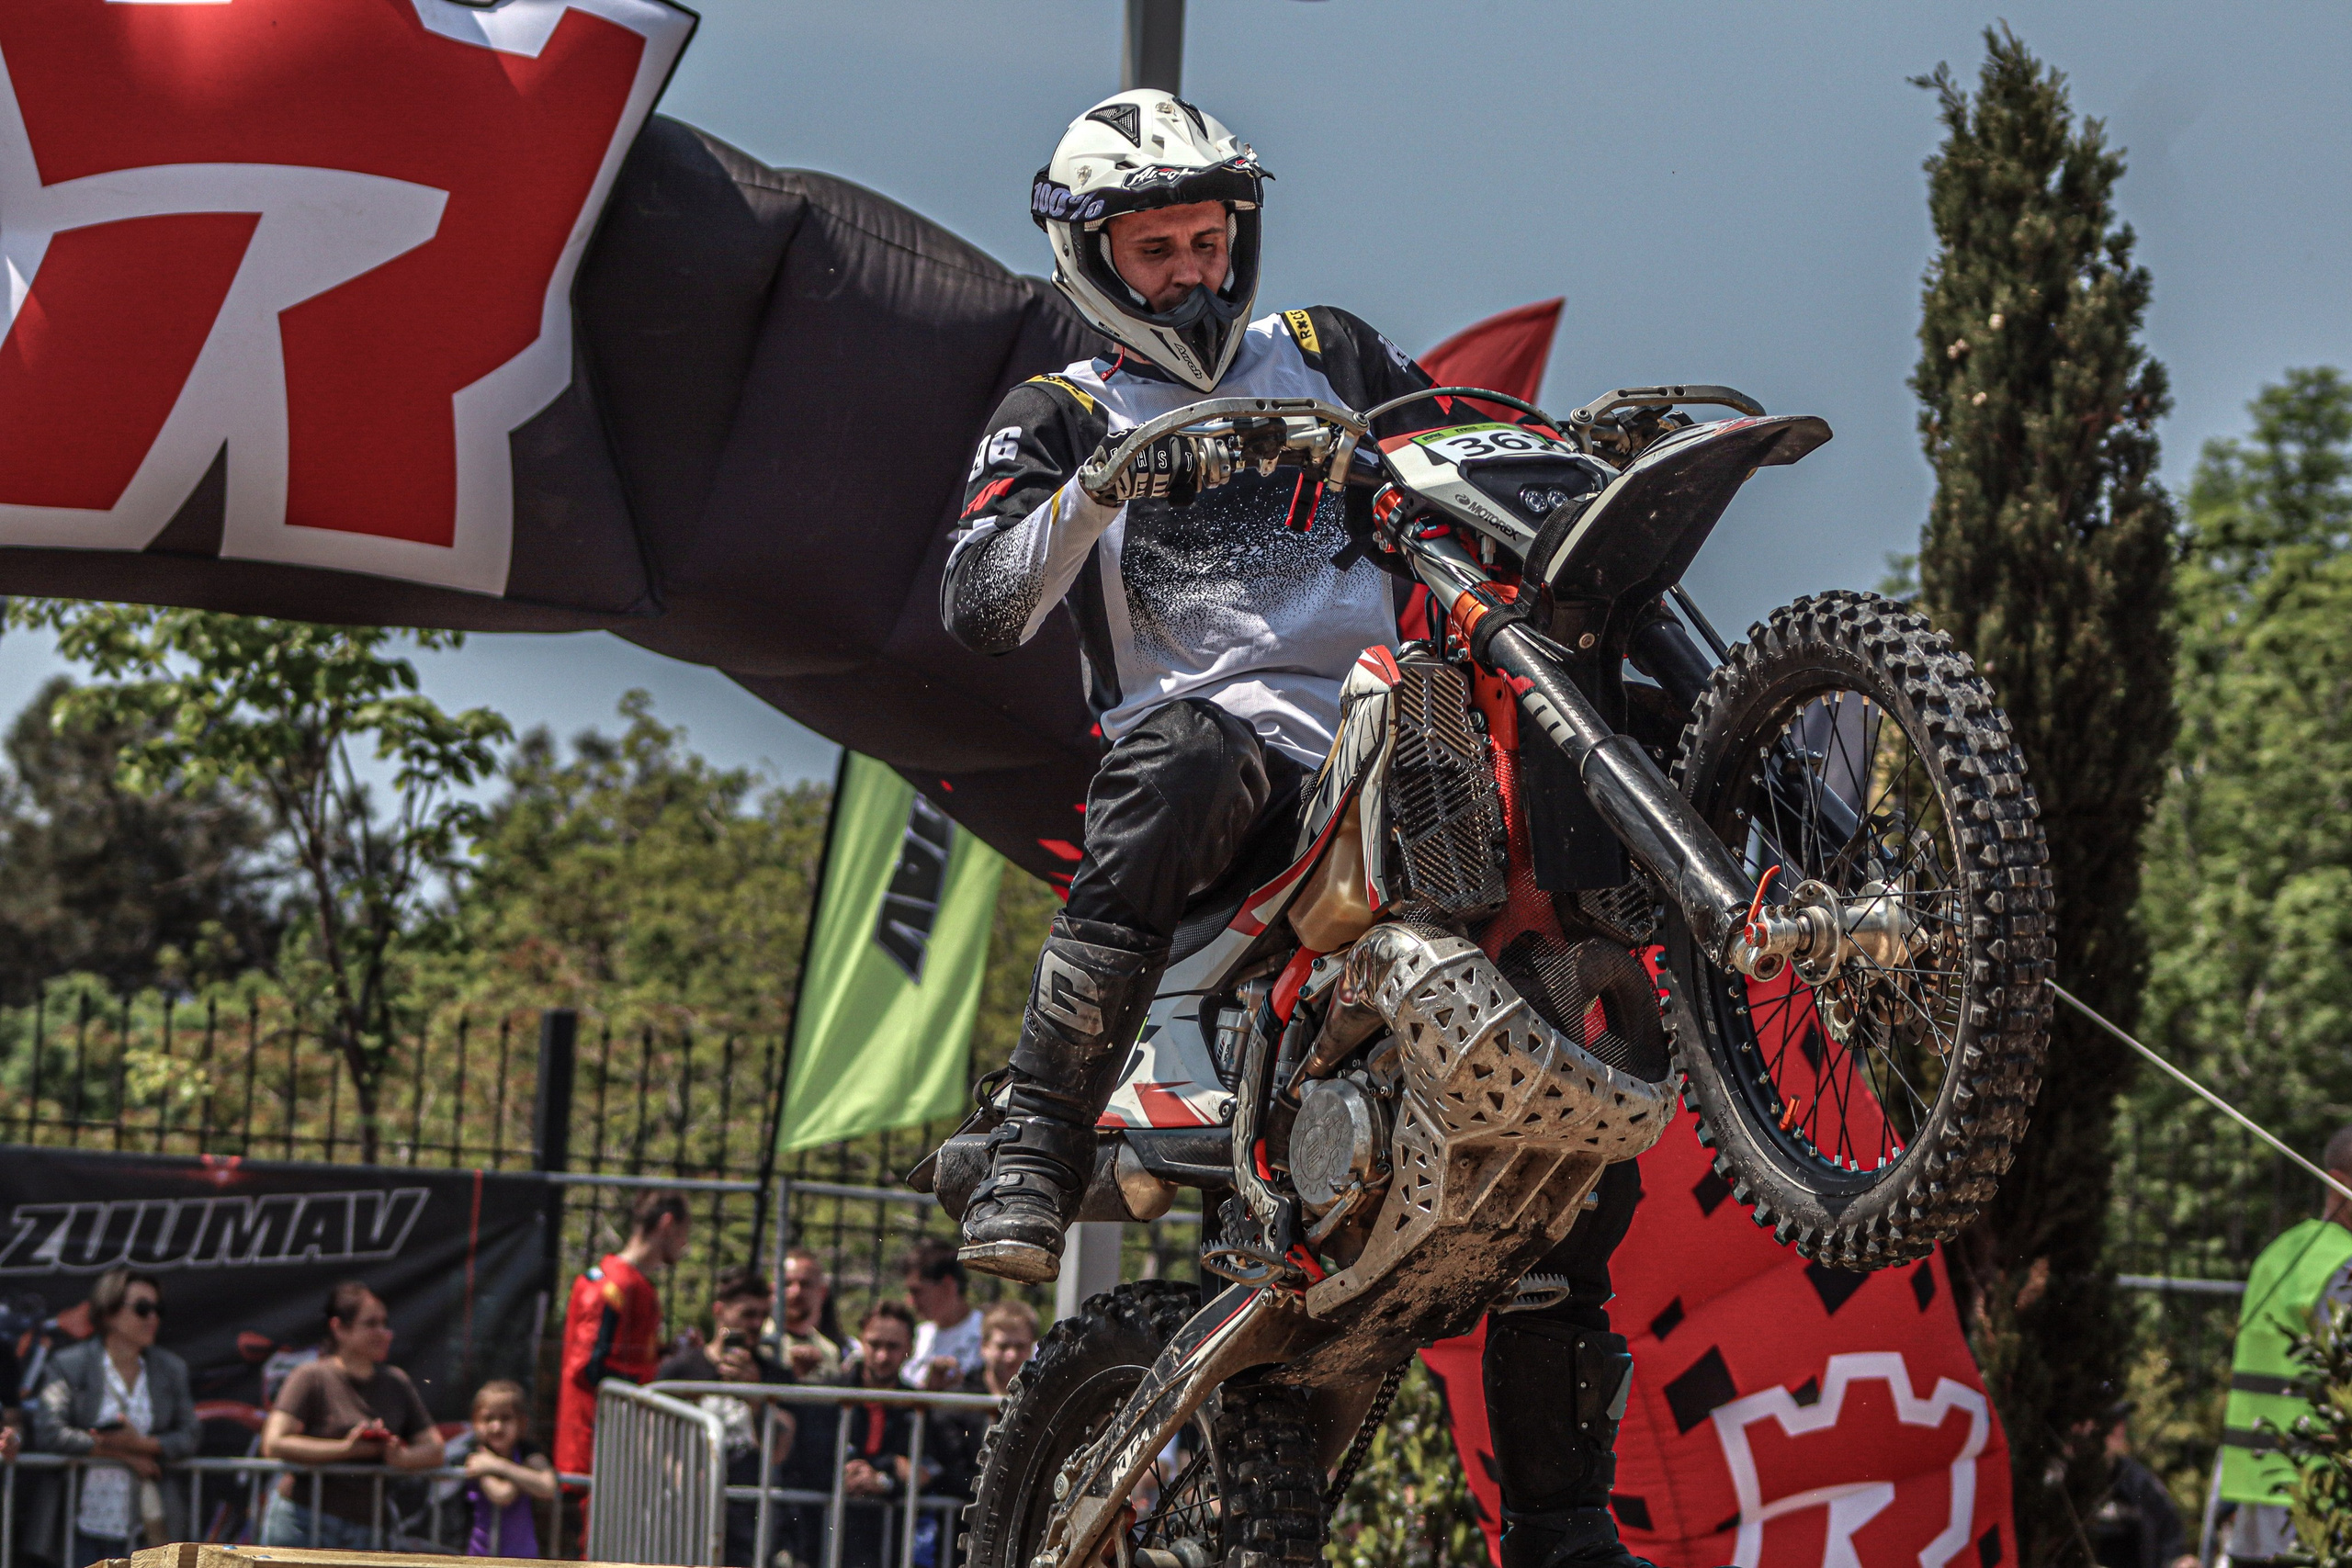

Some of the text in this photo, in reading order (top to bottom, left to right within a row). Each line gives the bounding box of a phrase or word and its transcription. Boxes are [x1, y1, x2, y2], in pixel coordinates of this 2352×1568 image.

[1032, 181, 1105, 220] 100%
[1173, 342, 1204, 380] Airoh
[1466, 501, 1521, 542] MOTOREX
[0, 1187, 431, 1276] ZUUMAV
